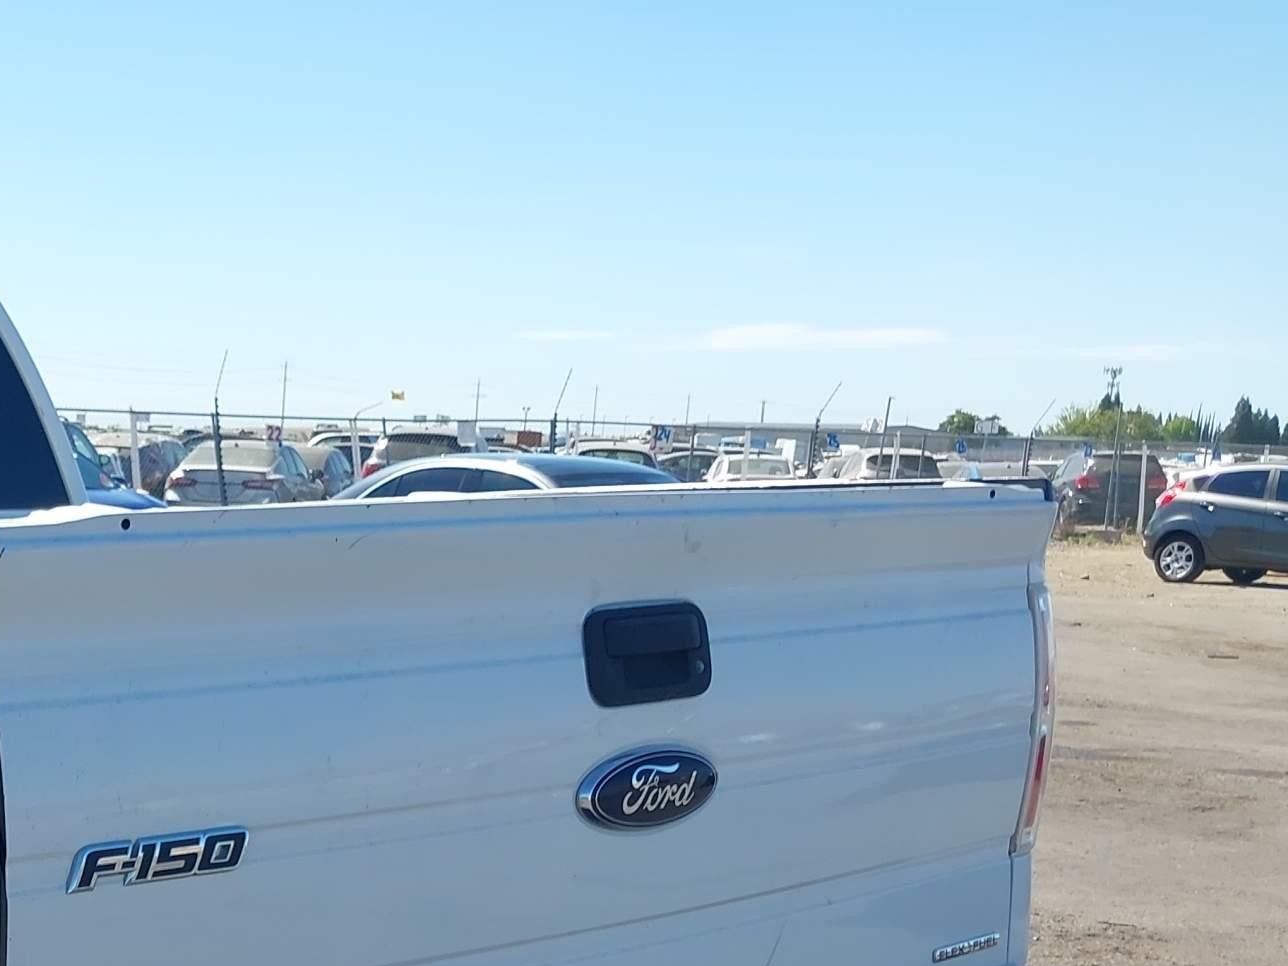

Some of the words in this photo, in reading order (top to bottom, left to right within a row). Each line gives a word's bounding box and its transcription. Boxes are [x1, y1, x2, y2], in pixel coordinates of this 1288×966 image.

[266, 425, 282, 440] 22
[657, 425, 671, 443] 24
[622, 762, 697, 815] Ford
[65, 824, 249, 895] F-150
